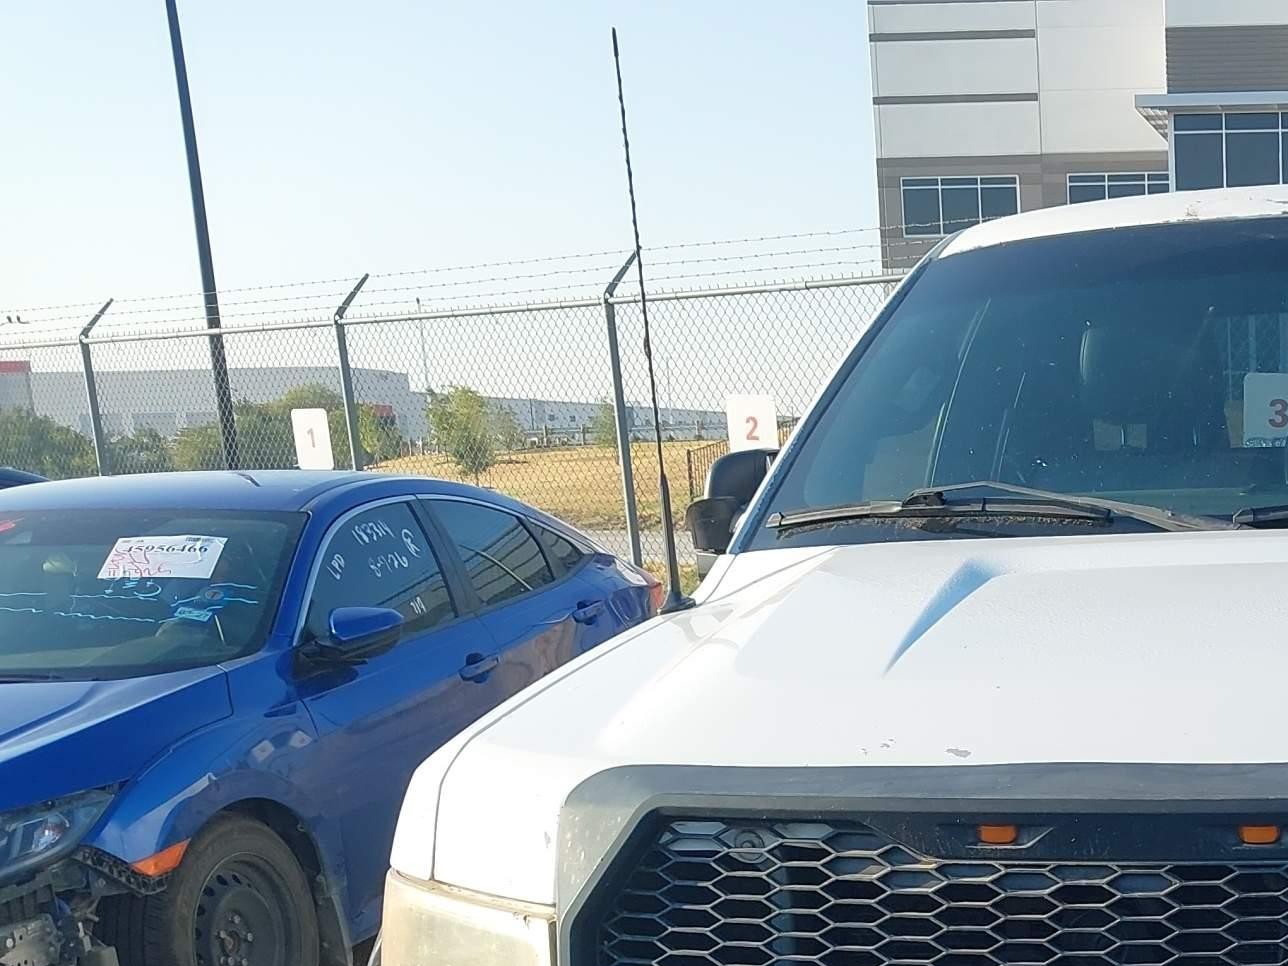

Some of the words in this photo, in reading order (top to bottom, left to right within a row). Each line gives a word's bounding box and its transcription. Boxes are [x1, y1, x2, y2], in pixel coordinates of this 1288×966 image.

[1269, 398, 1288, 428] 3
[307, 428, 316, 448] 1
[745, 416, 760, 441] 2
